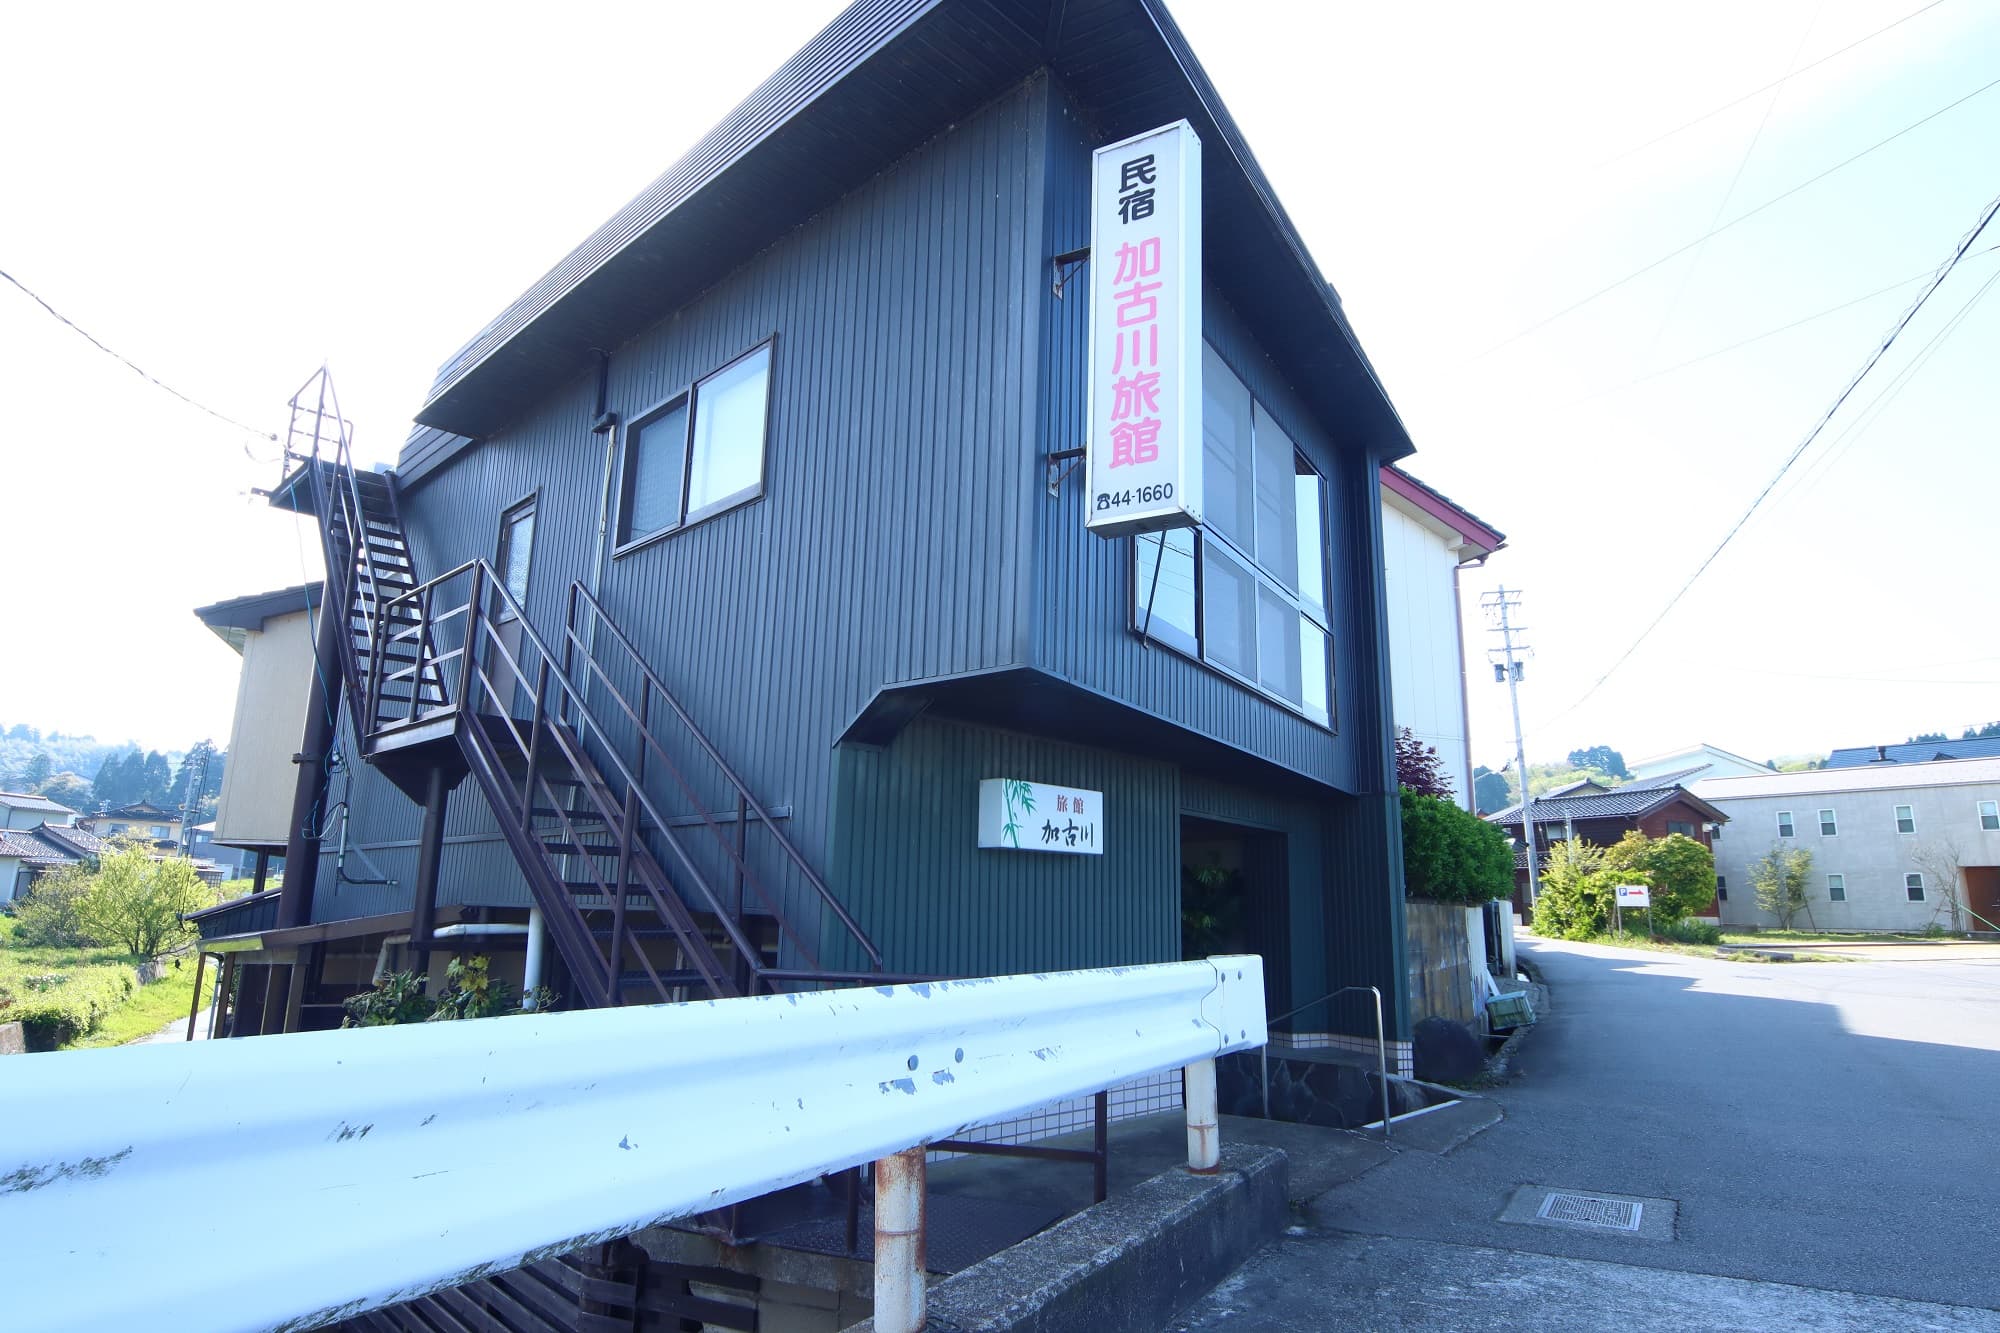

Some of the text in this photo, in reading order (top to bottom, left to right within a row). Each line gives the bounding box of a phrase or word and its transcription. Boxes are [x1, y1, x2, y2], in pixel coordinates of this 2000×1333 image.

[1118, 153, 1156, 225] 民宿
[1108, 236, 1163, 469] 加古川旅館
[1057, 794, 1084, 815] 旅館
[1041, 818, 1094, 848] 加古川
